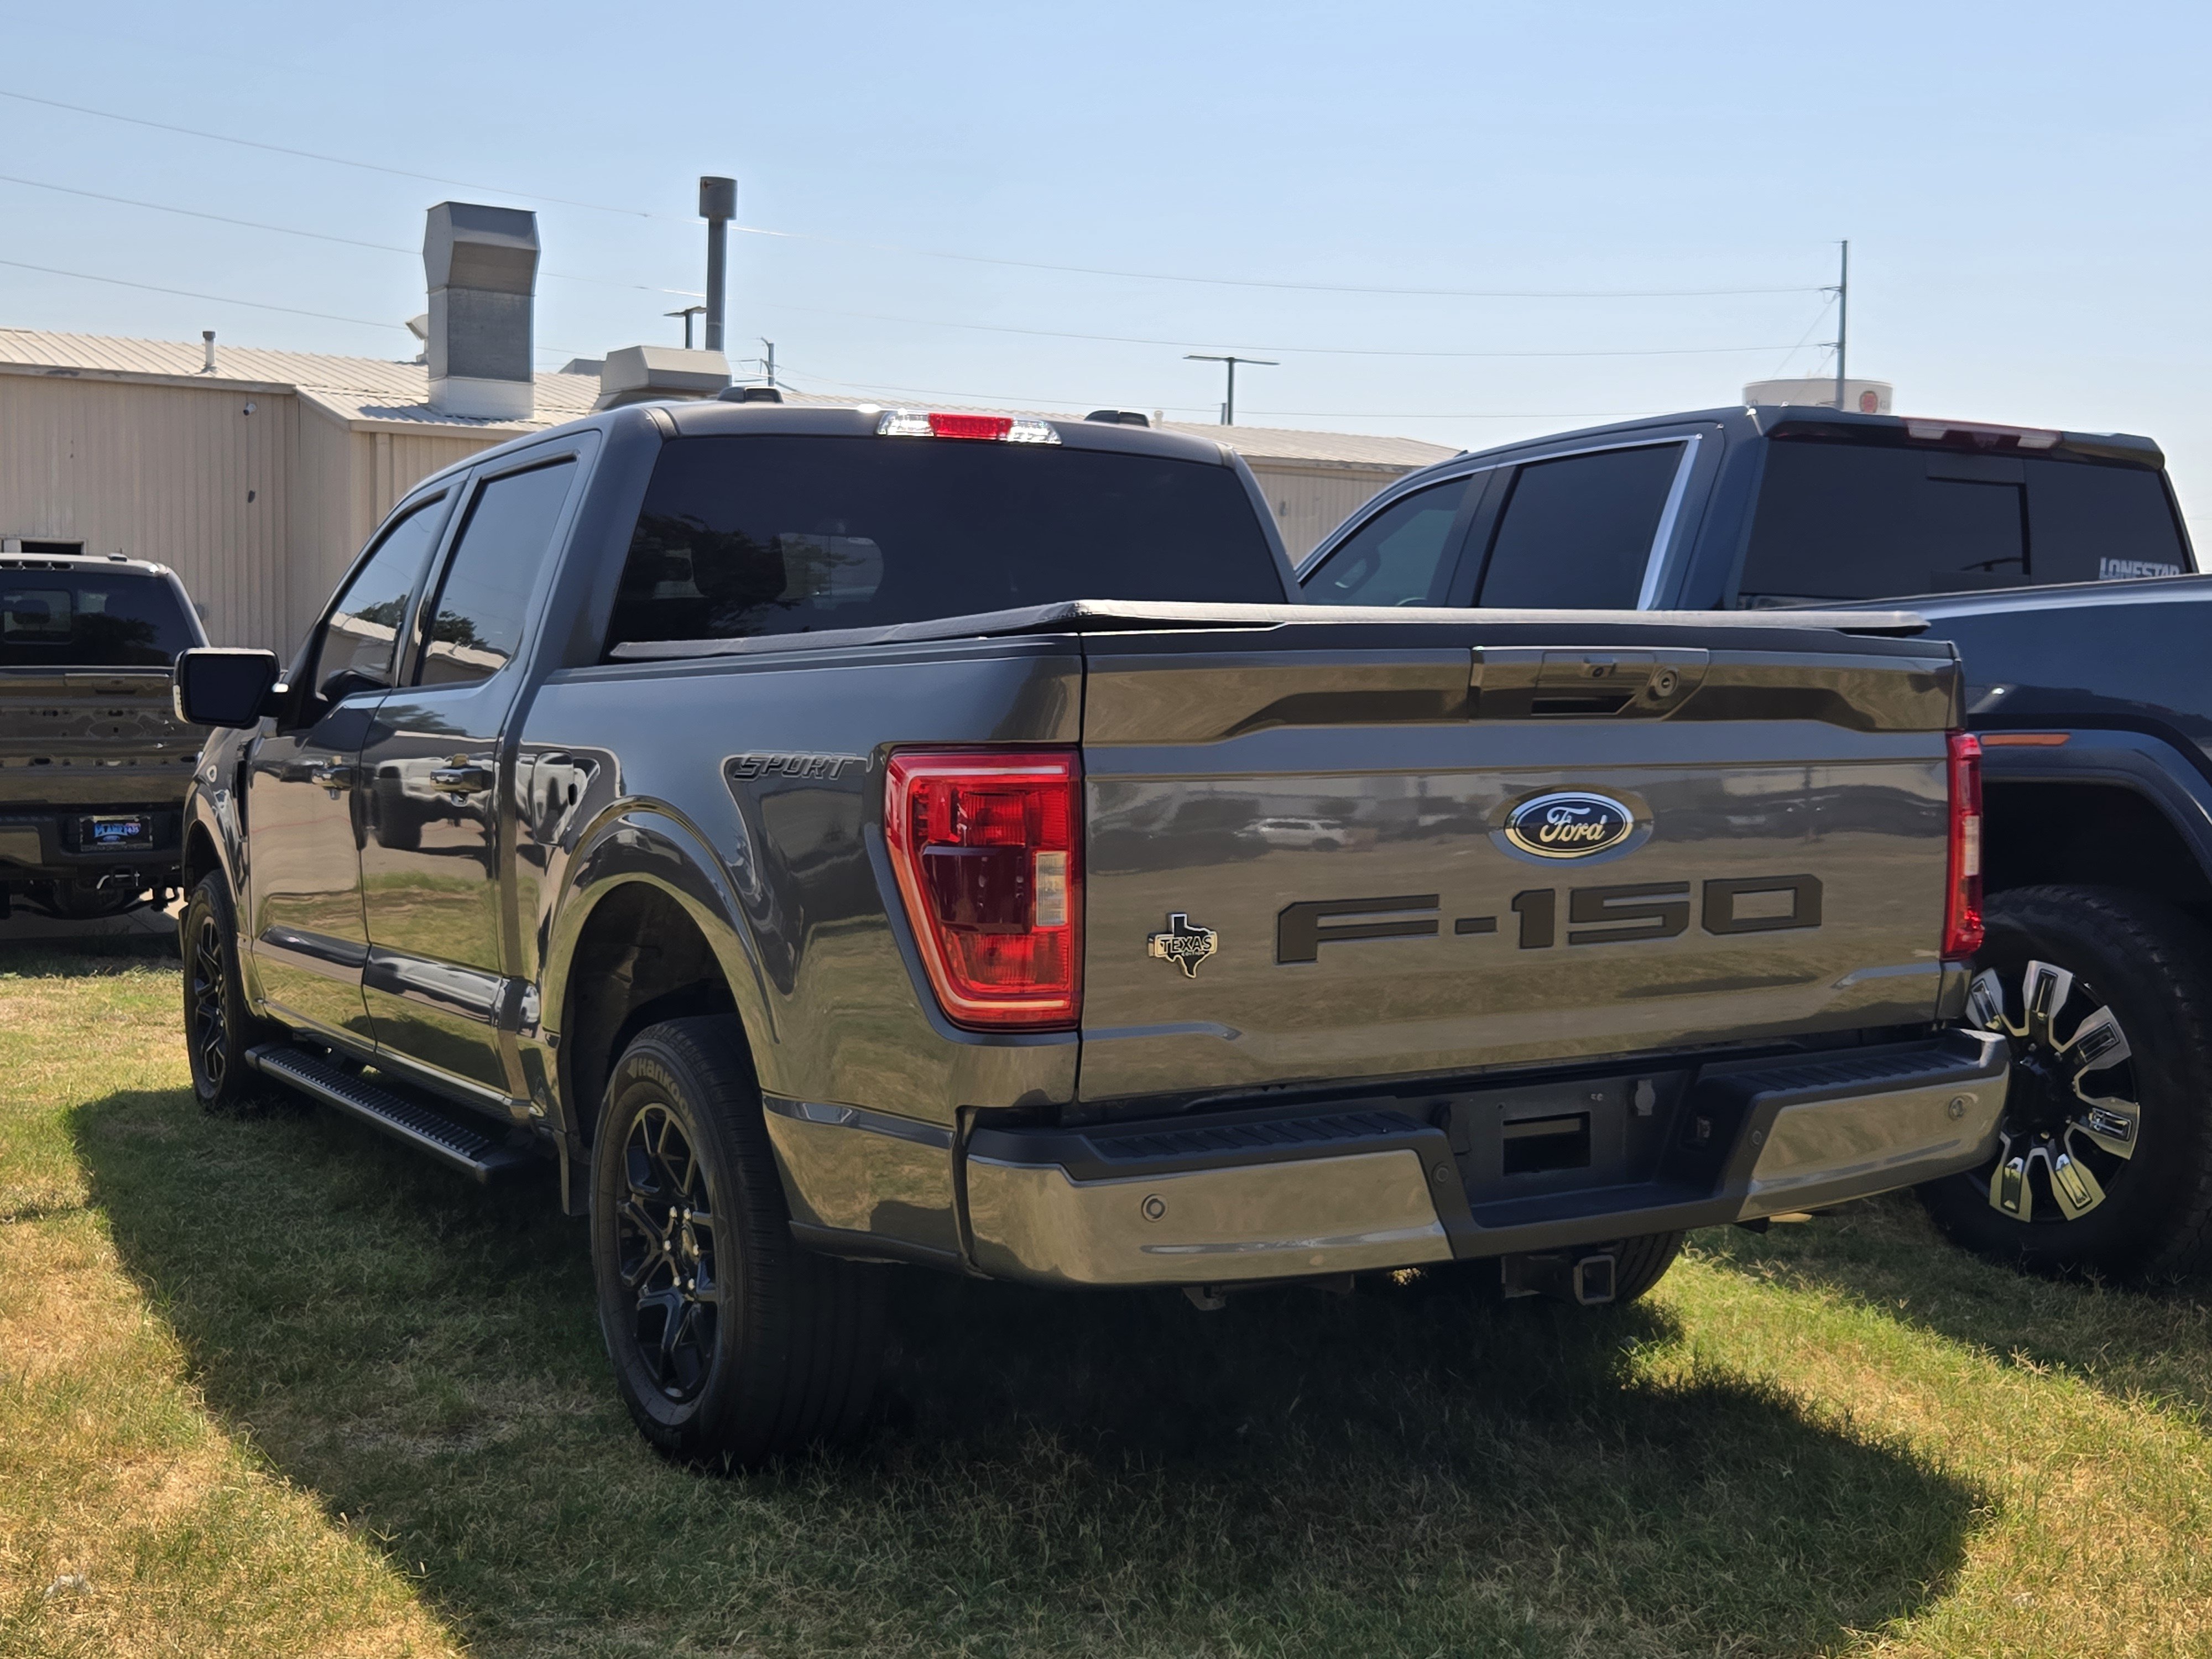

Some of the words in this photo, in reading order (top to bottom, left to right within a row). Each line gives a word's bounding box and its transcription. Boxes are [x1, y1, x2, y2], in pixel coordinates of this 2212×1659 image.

[733, 750, 857, 781] SPORT
[1540, 806, 1608, 842] Ford
[1276, 873, 1824, 964] F-150
[1159, 936, 1213, 953] TEXAS
